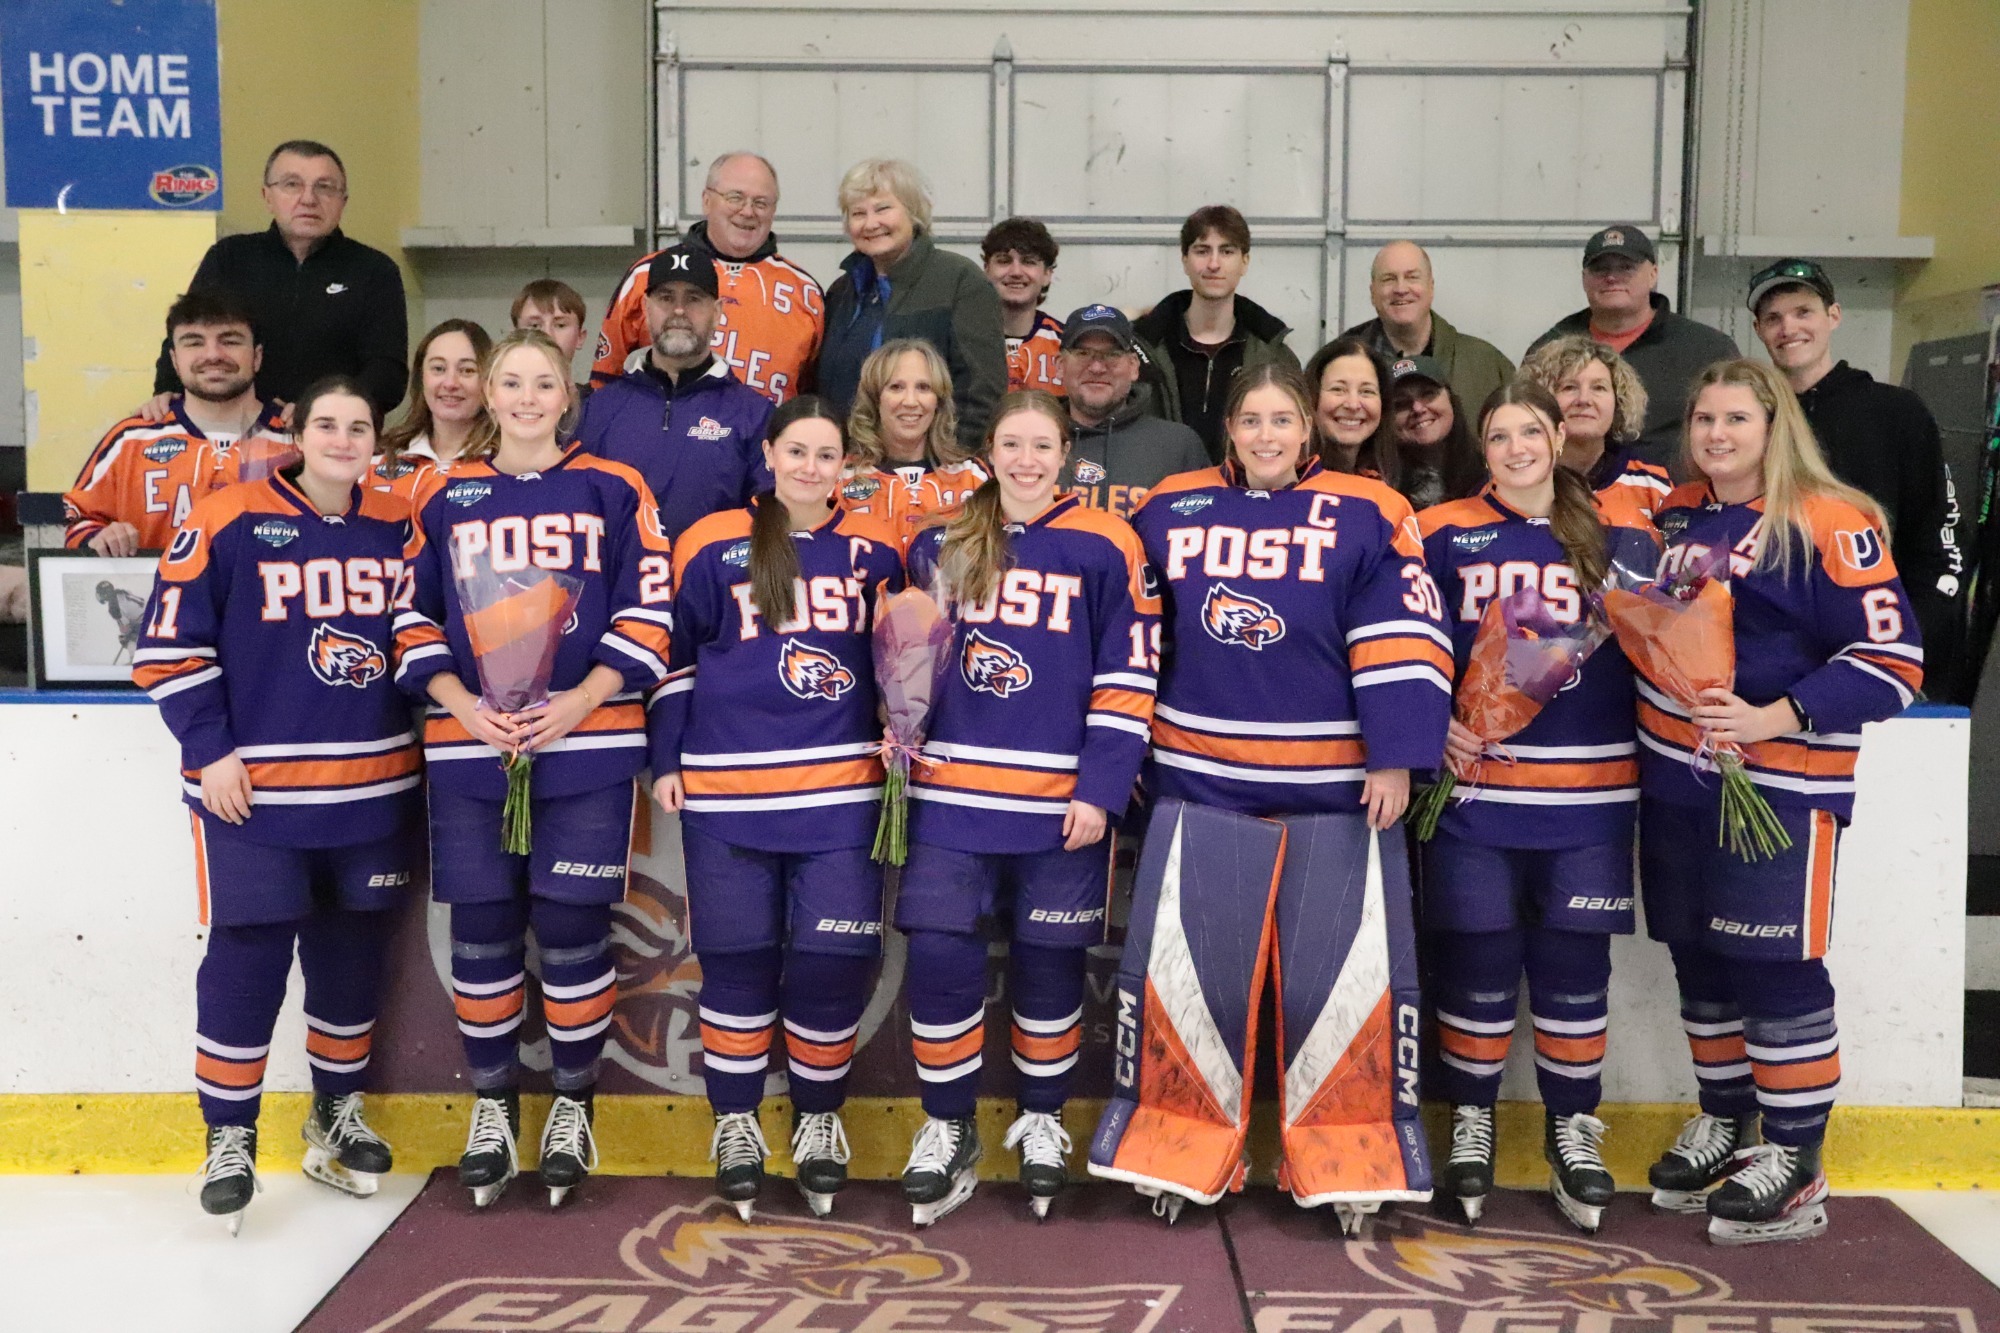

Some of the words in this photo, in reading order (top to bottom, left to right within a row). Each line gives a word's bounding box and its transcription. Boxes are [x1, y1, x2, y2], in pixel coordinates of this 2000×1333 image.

[30, 52, 189, 95] HOME
[31, 96, 191, 138] TEAM
[154, 173, 217, 192] RINKS
[772, 281, 794, 314] 5
[143, 443, 187, 458] NEWHA
[446, 486, 492, 499] NEWHA
[1170, 496, 1213, 510] NEWHA
[1306, 493, 1340, 529] C
[254, 526, 300, 538] NEWHA
[451, 512, 606, 580] POST
[1452, 531, 1499, 544] NEWHA
[849, 535, 873, 580] C
[1166, 525, 1338, 582] POST
[638, 555, 671, 606] 2
[1400, 563, 1443, 622] 30
[1457, 560, 1582, 625] POS
[1861, 588, 1903, 643] 6
[552, 861, 625, 879] BAUER
[1029, 908, 1104, 924] BAUER
[1710, 917, 1798, 938] BAUER
[1115, 987, 1137, 1088] CCM
[1398, 1004, 1419, 1107] CCM
[423, 1292, 1125, 1333] EAGLES
